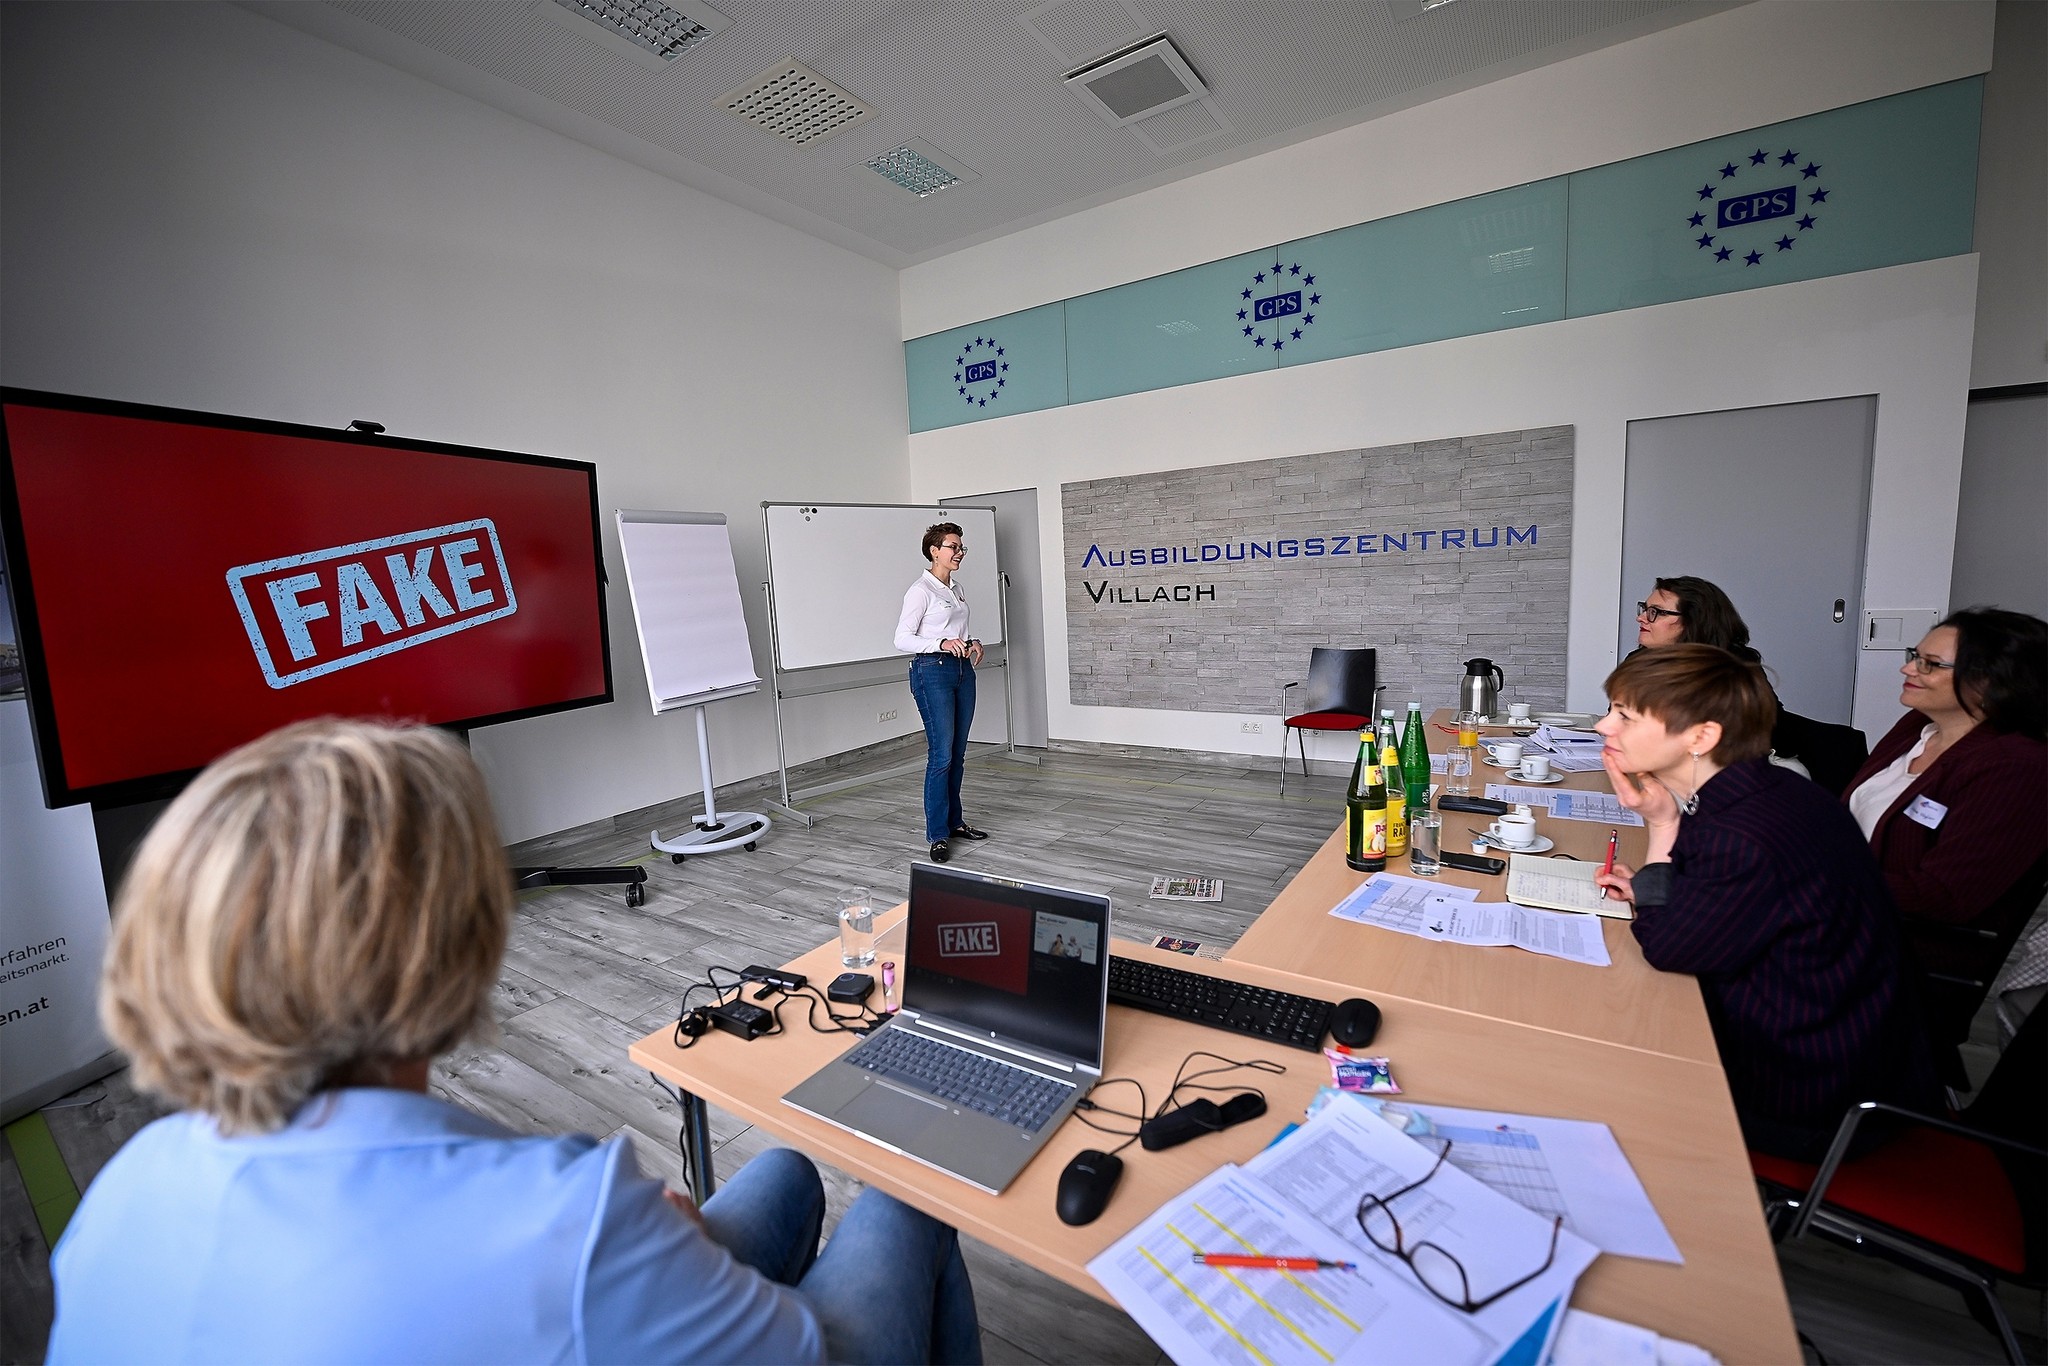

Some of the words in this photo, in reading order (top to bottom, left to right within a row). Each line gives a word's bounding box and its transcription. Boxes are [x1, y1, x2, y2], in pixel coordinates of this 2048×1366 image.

[1724, 192, 1789, 222] GPS
[1258, 295, 1298, 317] GPS
[968, 363, 994, 380] GPS
[1081, 524, 1538, 569] AUSBILDUNGSZENTRUM
[265, 537, 495, 662] FAKE
[1083, 580, 1216, 604] VILLACH
[943, 926, 994, 953] FAKE
